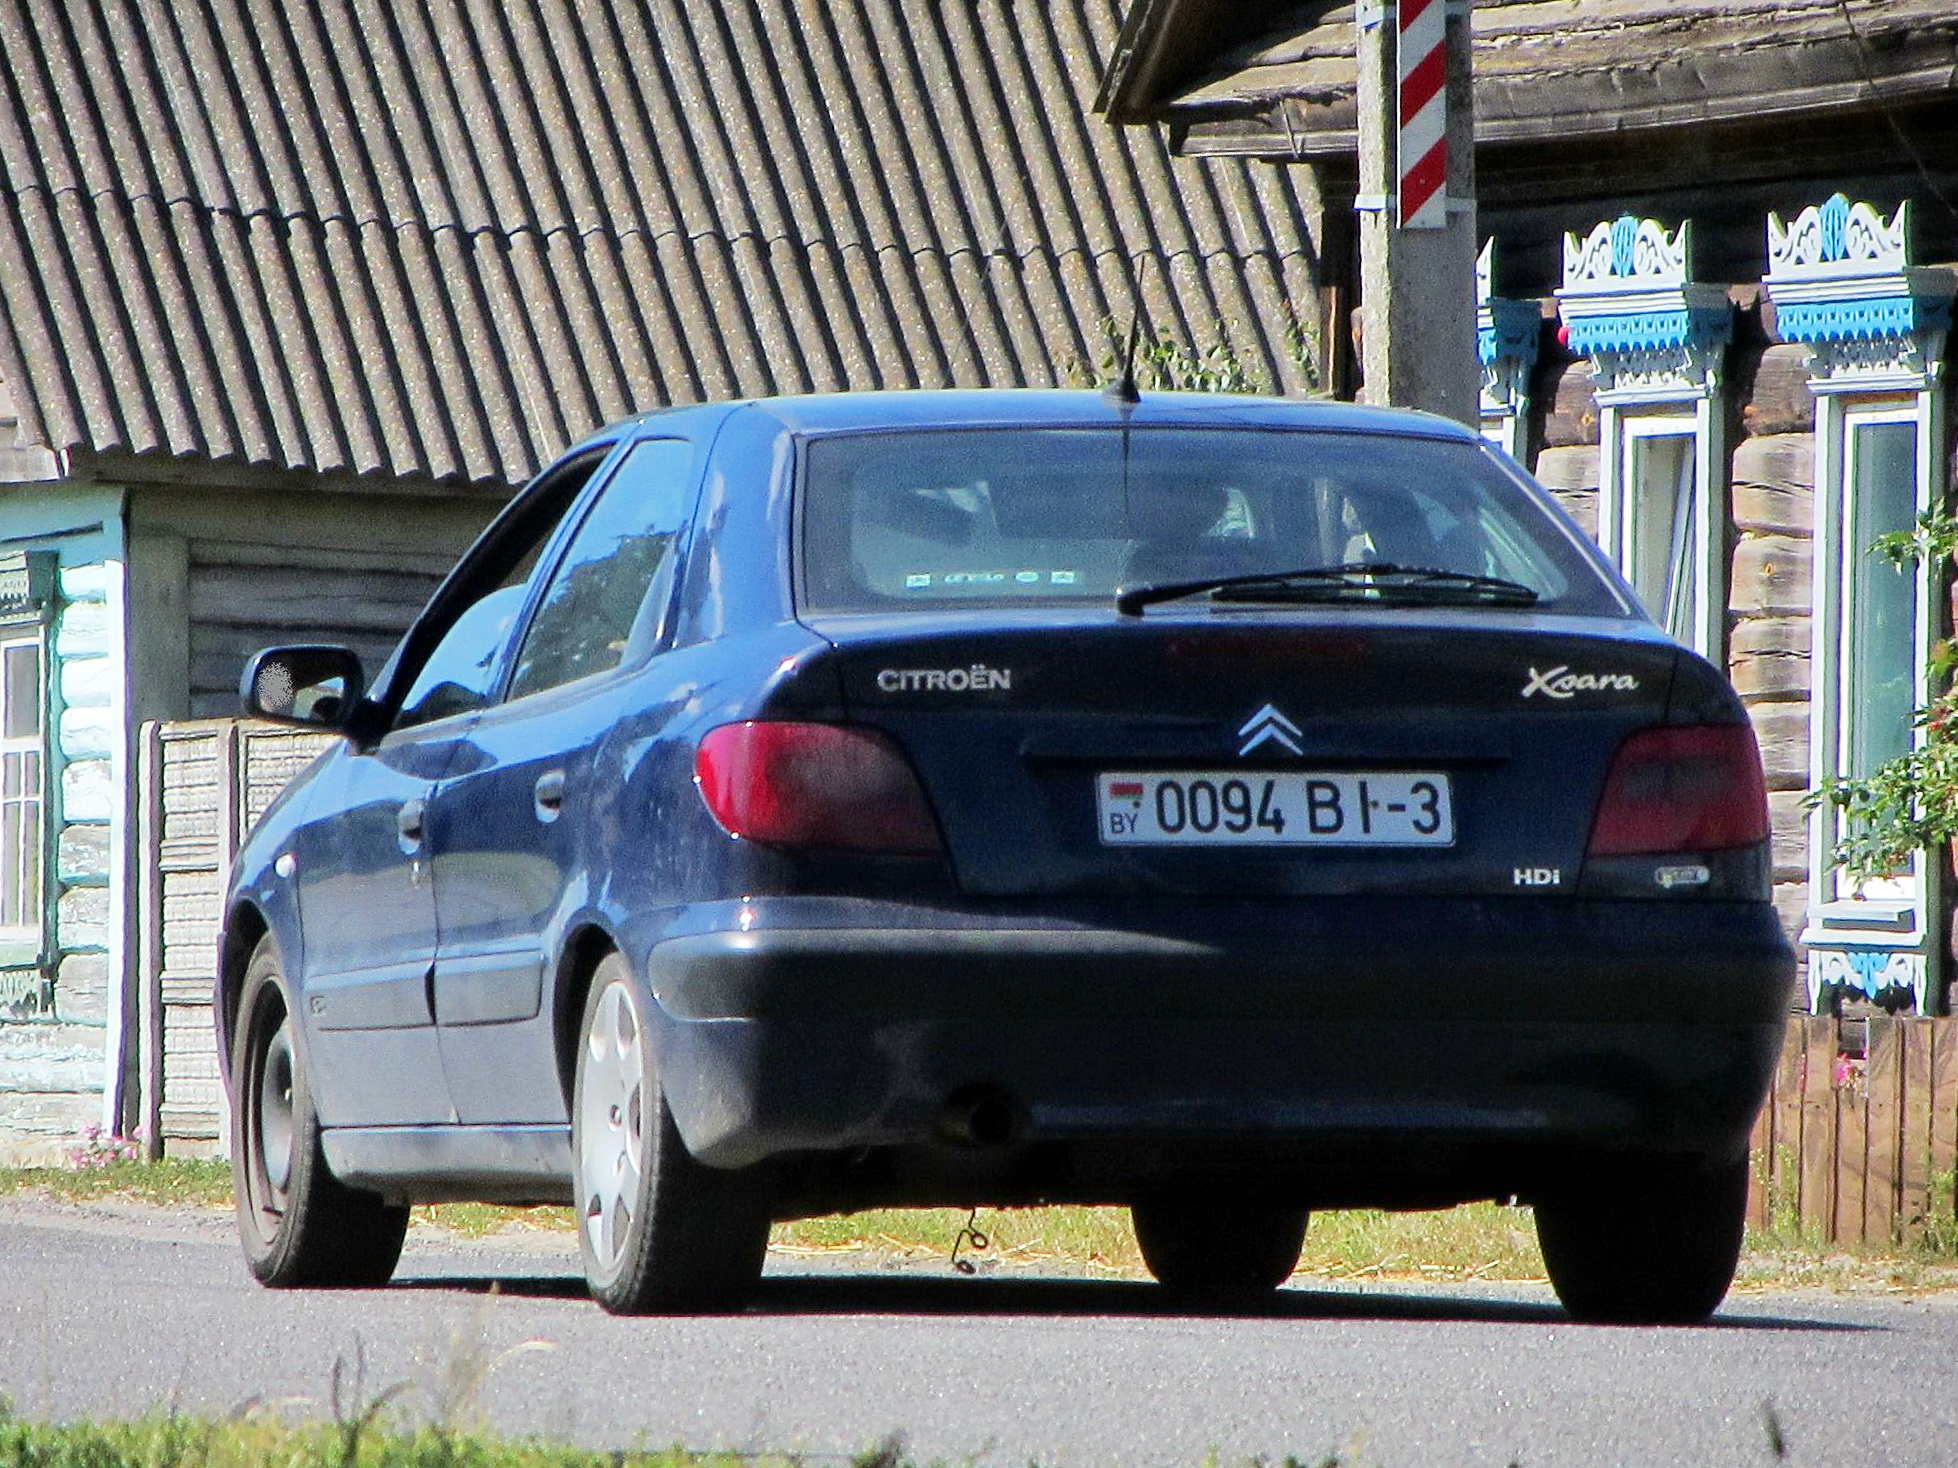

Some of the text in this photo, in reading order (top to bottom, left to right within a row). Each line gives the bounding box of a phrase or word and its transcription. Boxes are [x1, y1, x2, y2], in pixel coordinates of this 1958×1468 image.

[877, 664, 1011, 692] CITROËN
[1155, 779, 1440, 834] 0094 BI-3
[1109, 812, 1138, 834] BY
[1513, 867, 1560, 886] HDi
